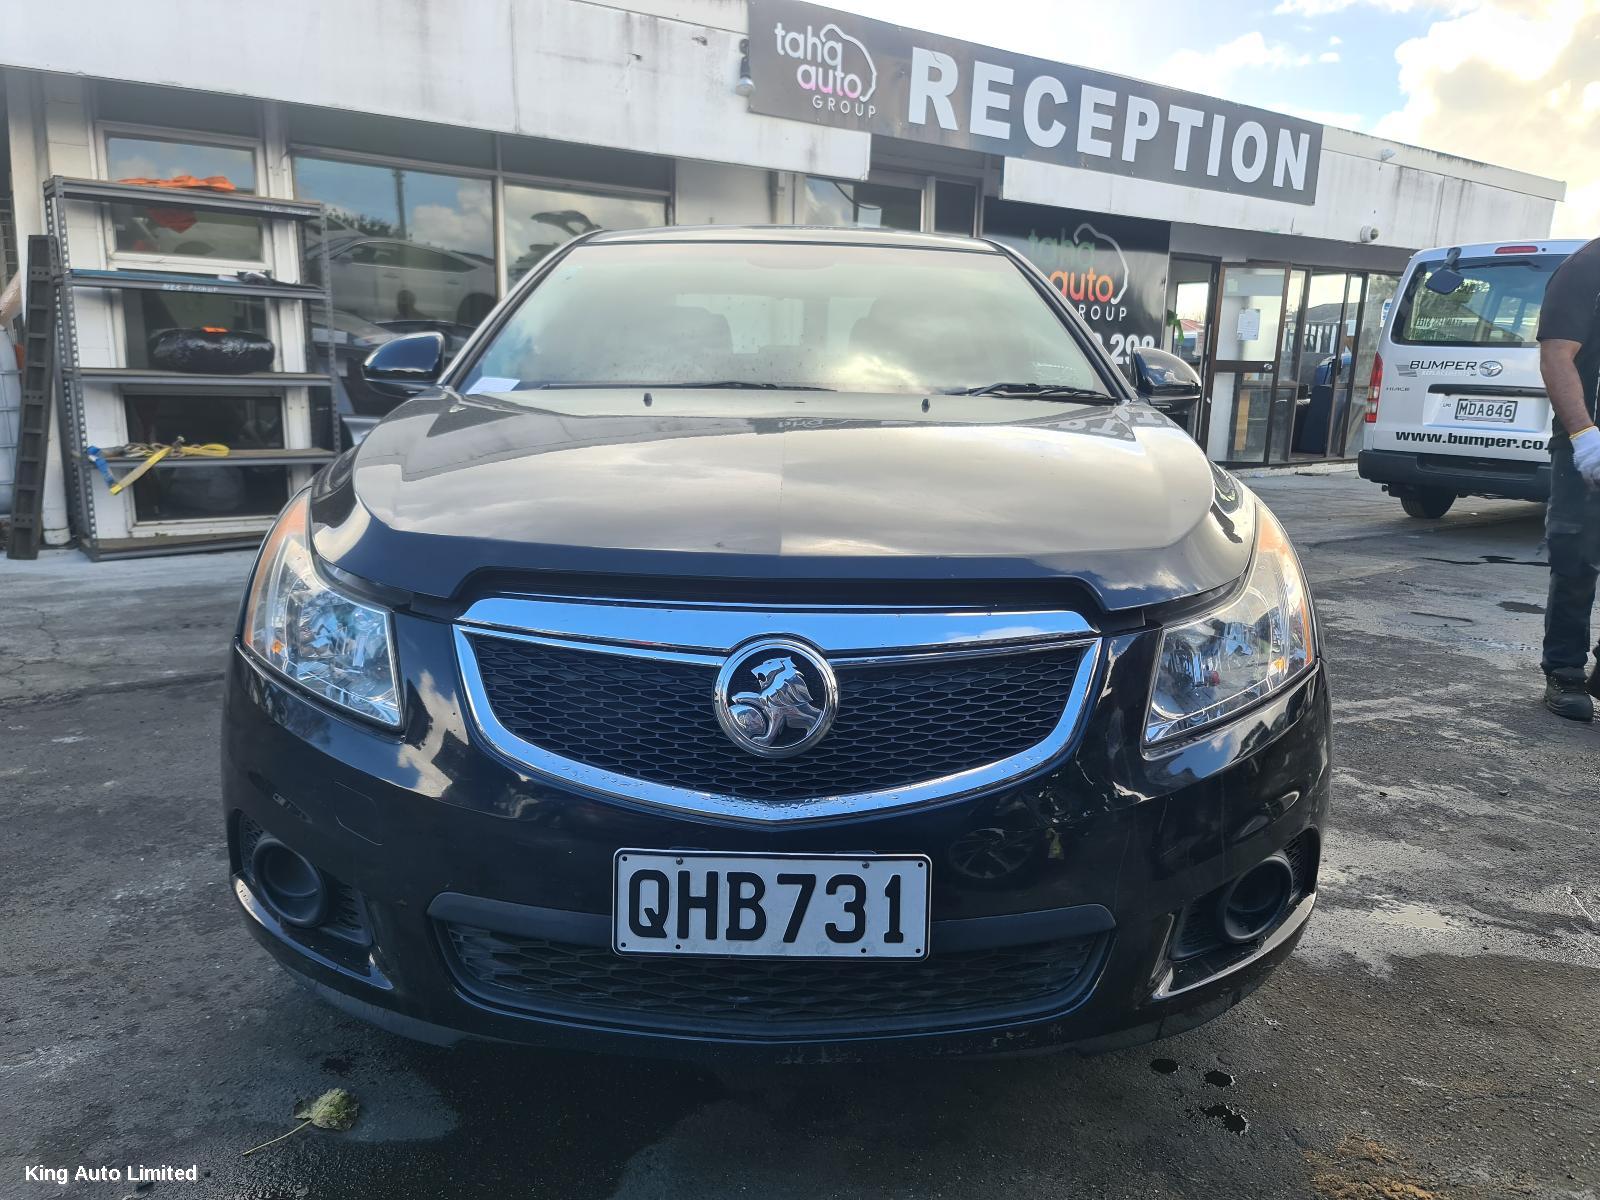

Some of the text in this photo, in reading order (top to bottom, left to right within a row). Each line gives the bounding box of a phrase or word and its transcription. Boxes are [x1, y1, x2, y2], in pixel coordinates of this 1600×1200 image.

[774, 22, 842, 67] taha
[797, 64, 862, 99] auto
[812, 95, 876, 118] GROUP
[908, 46, 1311, 191] RECEPTION
[1048, 267, 1114, 302] auto
[1078, 304, 1127, 322] ROUP
[1409, 360, 1477, 371] BUMPER
[1458, 402, 1513, 418] MDA846
[628, 869, 904, 943] QHB731
